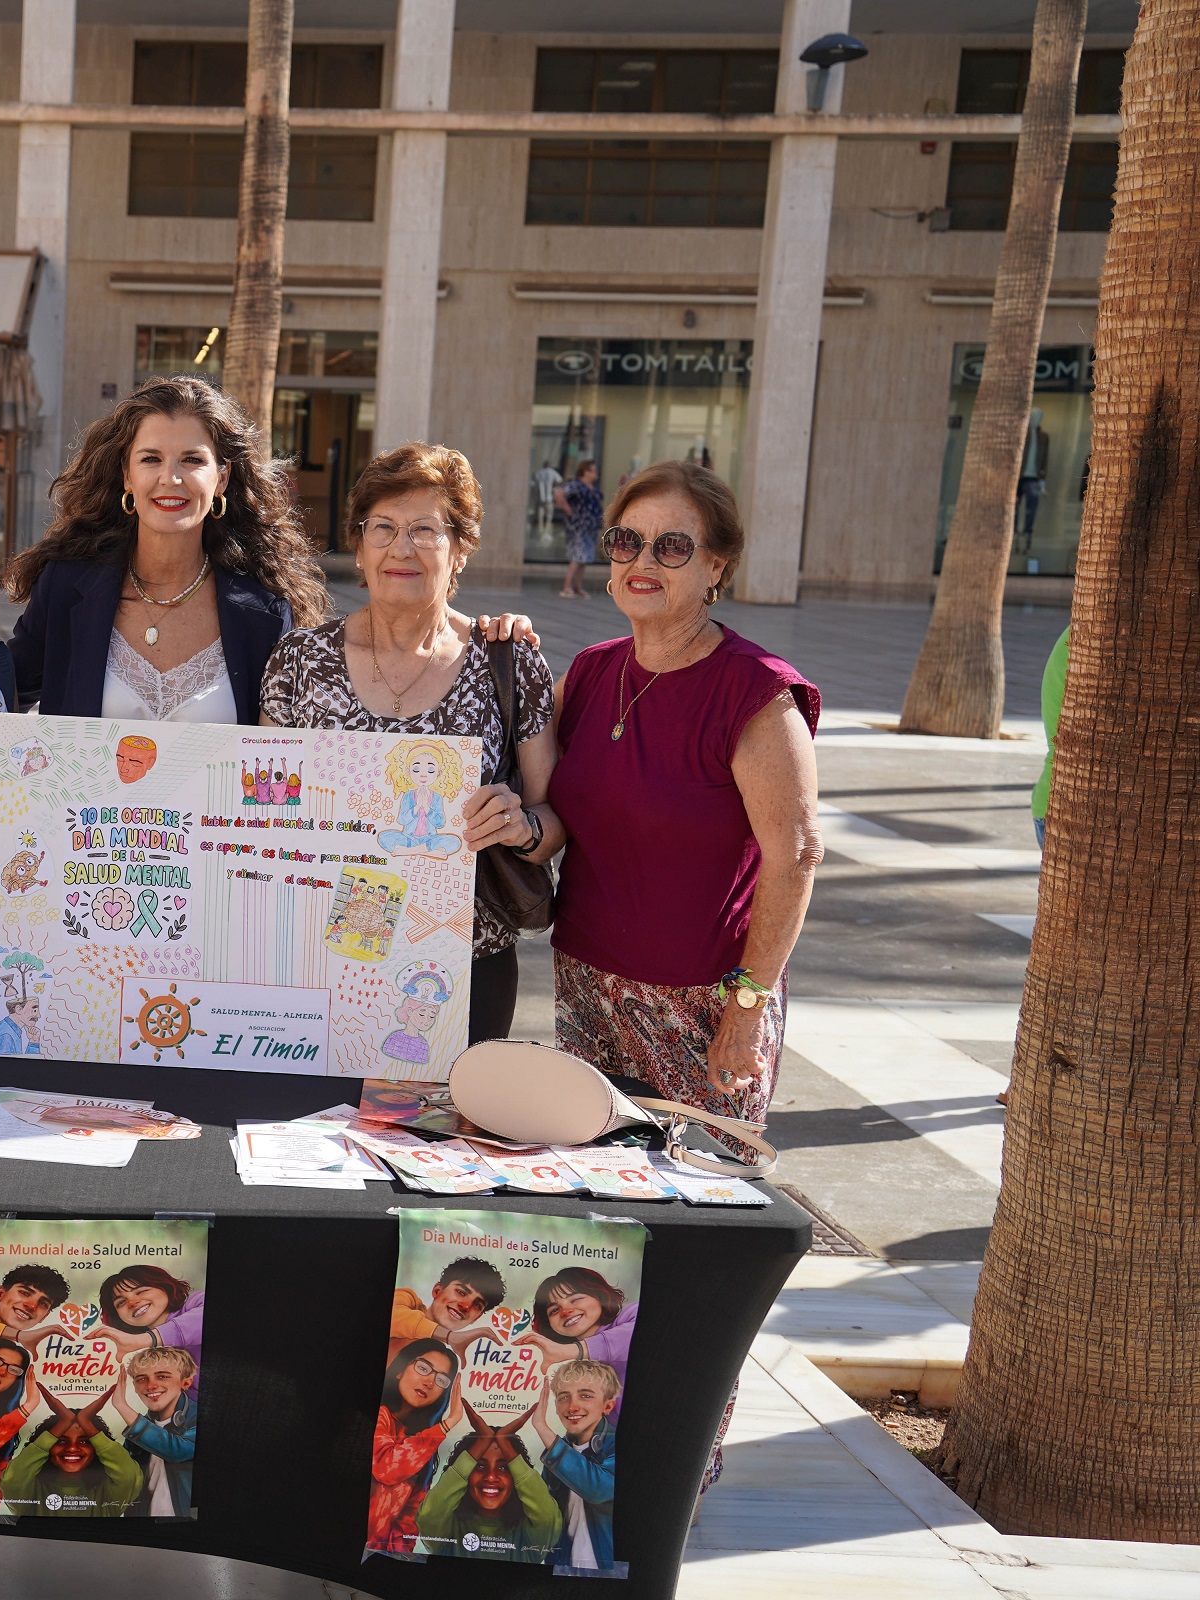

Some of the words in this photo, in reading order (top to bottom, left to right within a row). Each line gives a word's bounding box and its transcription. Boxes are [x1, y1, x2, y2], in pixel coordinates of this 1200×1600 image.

[601, 353, 667, 372] TOM
[674, 353, 753, 373] TAIL
[1035, 359, 1078, 379] OM
[80, 807, 97, 825] 10
[100, 807, 118, 824] DE
[121, 807, 180, 828] OCTUBRE
[201, 815, 232, 828] Hablar
[234, 816, 245, 827] de
[247, 817, 271, 828] salud
[273, 818, 314, 830] mental
[319, 820, 334, 830] es
[336, 820, 376, 835] cuidar,
[72, 826, 105, 851] DÍA
[110, 827, 188, 855] MUNDIAL
[112, 850, 126, 861] DE
[130, 850, 146, 862] LA
[200, 840, 214, 851] es
[216, 841, 257, 856] apoyar,
[262, 848, 275, 859] es
[279, 847, 316, 863] luchar
[320, 853, 340, 864] para
[63, 861, 121, 885] SALUD
[125, 864, 191, 889] MENTAL
[226, 868, 234, 879] y
[235, 868, 273, 882] eliminar
[285, 874, 294, 884] el
[296, 875, 334, 889] estigma.
[210, 1008, 240, 1016] SALUD
[241, 1010, 277, 1018] MENTAL
[283, 1012, 323, 1020] ALMERÍA
[212, 1033, 243, 1056] El
[252, 1035, 319, 1061] Timón
[9, 1243, 64, 1256] Mundial
[67, 1246, 79, 1256] de
[81, 1246, 90, 1256] la
[93, 1244, 131, 1256] Salud
[135, 1244, 182, 1256] Mental
[450, 1231, 503, 1249] Mundial
[506, 1240, 518, 1251] de
[520, 1241, 529, 1252] la
[531, 1240, 569, 1256] Salud
[573, 1246, 619, 1260] Mental
[70, 1260, 102, 1270] 2026
[509, 1257, 540, 1269] 2026
[45, 1335, 84, 1359] Haz
[473, 1338, 512, 1366] Haz
[42, 1351, 118, 1377] match
[468, 1360, 542, 1393] match
[75, 1384, 107, 1392] mental
[472, 1400, 496, 1409] salud
[498, 1402, 529, 1410] mental
[497, 1542, 516, 1550] MENTAL
